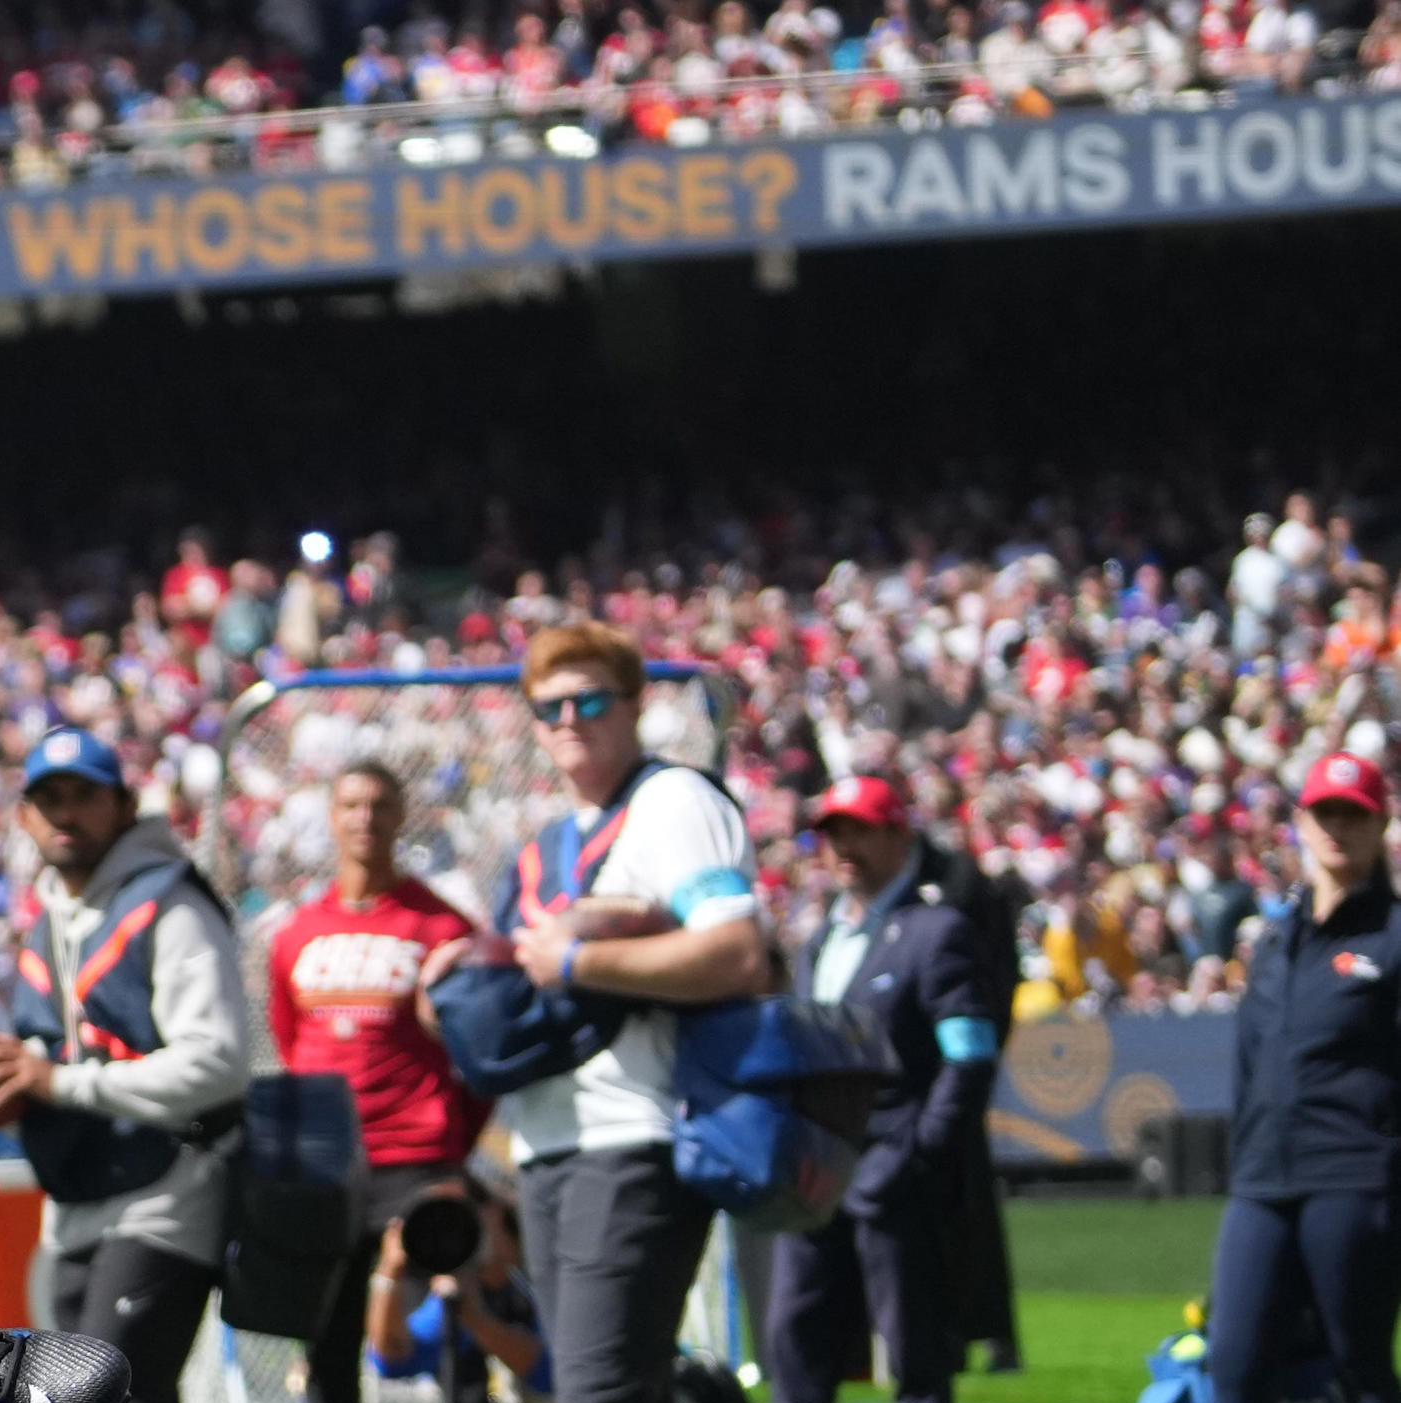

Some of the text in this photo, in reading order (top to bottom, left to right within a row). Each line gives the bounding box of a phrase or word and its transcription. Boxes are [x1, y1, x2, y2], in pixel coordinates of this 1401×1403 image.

[8, 181, 374, 284] WHOSE
[399, 149, 796, 257] HOUSE?
[821, 123, 1132, 230] RAMS
